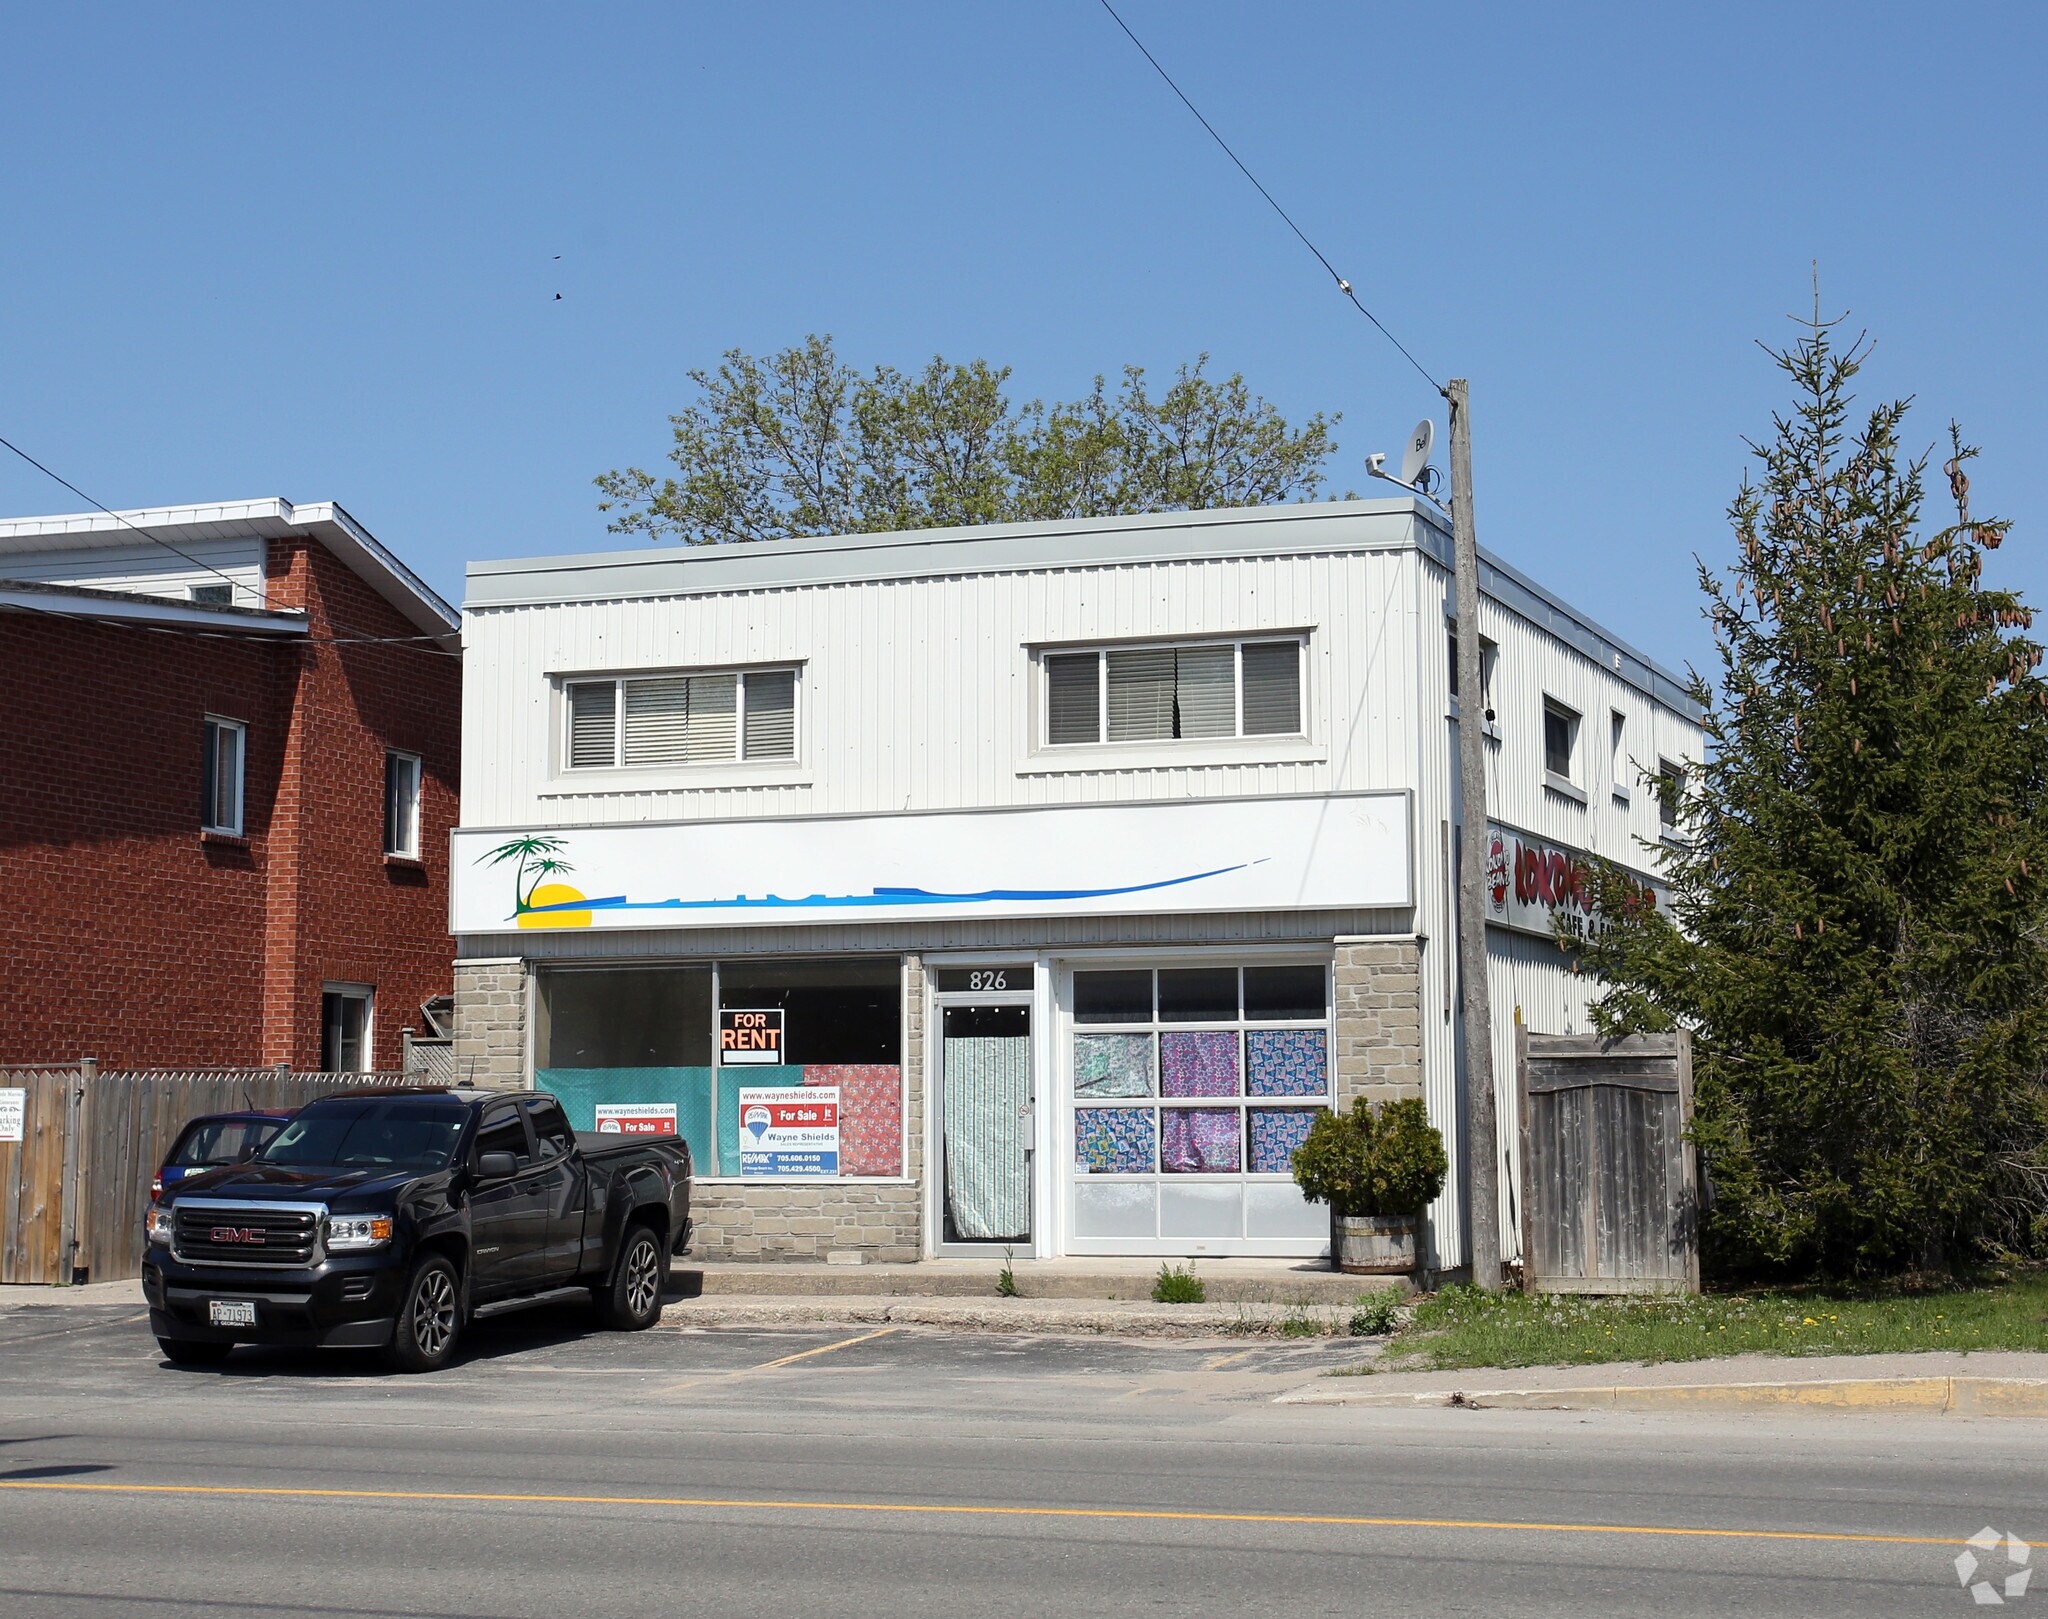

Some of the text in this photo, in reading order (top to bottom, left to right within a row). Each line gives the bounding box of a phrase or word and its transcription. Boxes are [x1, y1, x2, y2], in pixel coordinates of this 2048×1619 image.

[970, 970, 1007, 991] 826
[734, 1013, 767, 1028] FOR
[720, 1028, 781, 1050] RENT
[742, 1090, 836, 1101] www.wayneshields.com
[597, 1106, 676, 1116] www.wayneshields.com
[780, 1109, 818, 1121] For Sale
[0, 1115, 21, 1128] arking
[625, 1122, 656, 1132] For Sale
[767, 1132, 835, 1142] Wayne Shields
[776, 1154, 821, 1162] 705.606.0150
[777, 1165, 821, 1173] 705.429.4500
[210, 1226, 267, 1244] GMC
